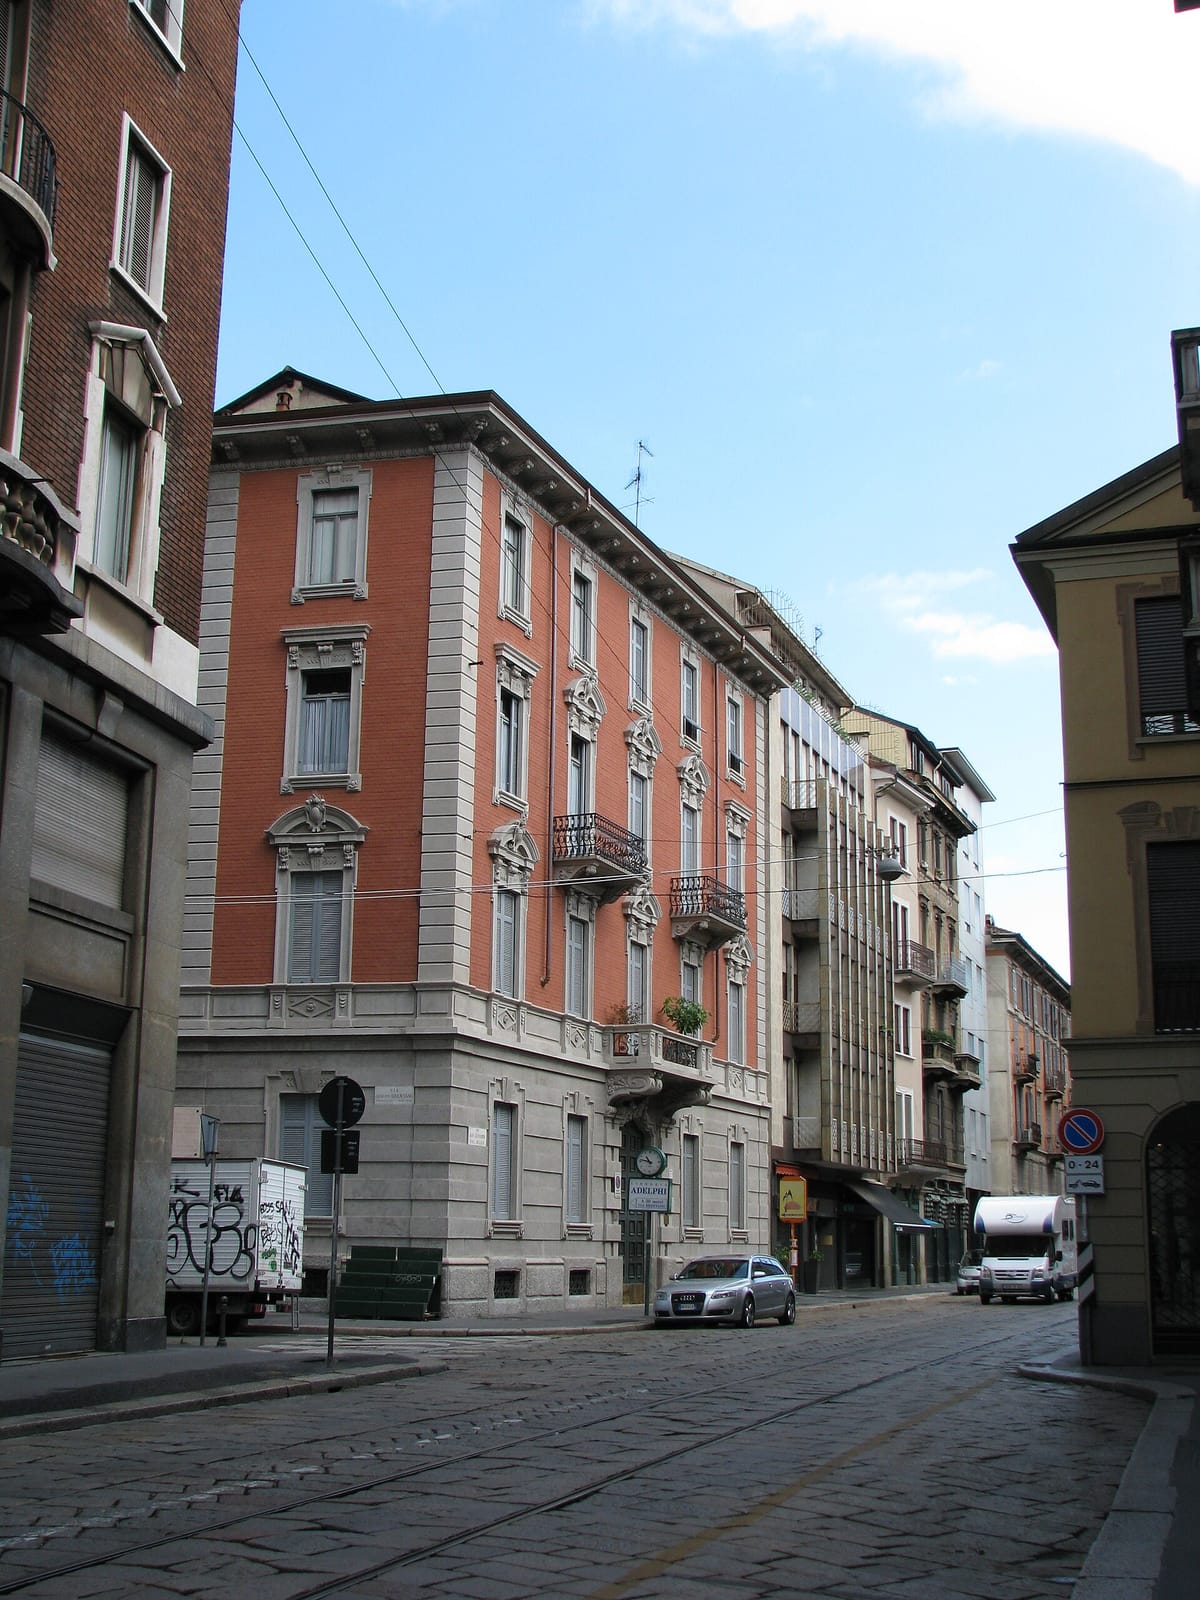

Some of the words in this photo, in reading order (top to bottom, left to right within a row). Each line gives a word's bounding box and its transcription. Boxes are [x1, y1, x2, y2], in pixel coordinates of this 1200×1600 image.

[1068, 1160, 1076, 1169] 0
[1084, 1160, 1099, 1169] 24
[631, 1187, 666, 1195] ADELPHI
